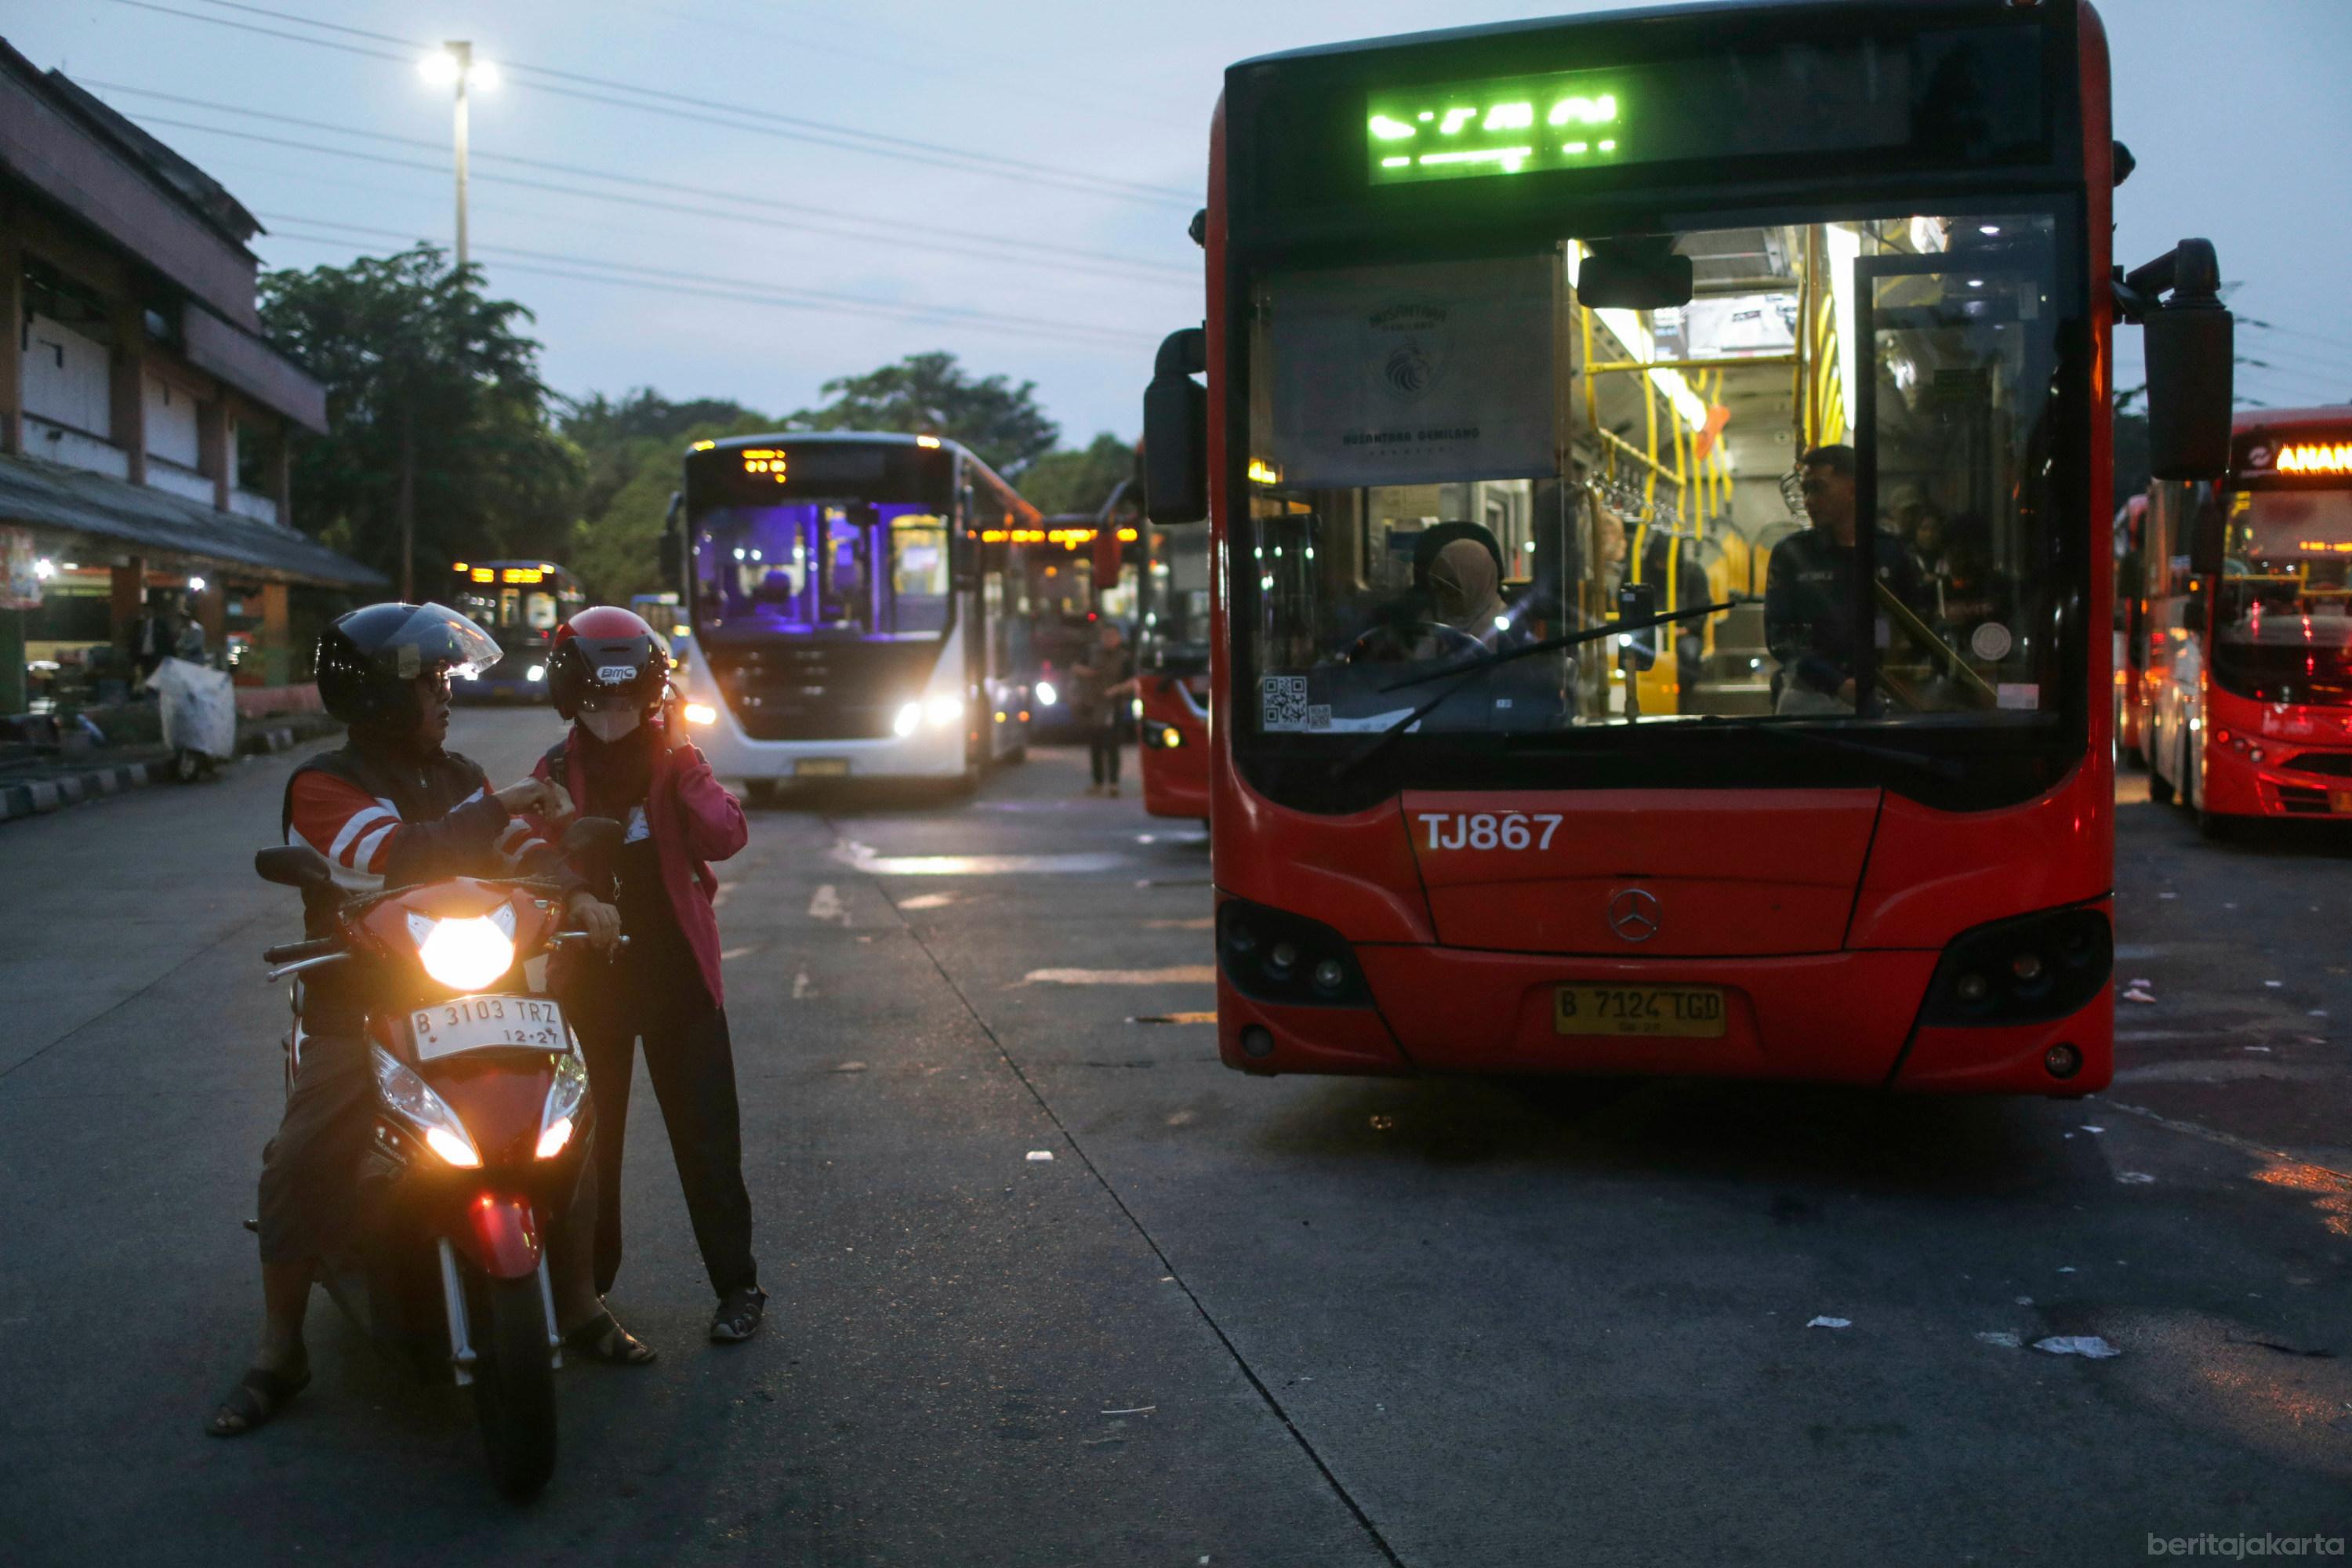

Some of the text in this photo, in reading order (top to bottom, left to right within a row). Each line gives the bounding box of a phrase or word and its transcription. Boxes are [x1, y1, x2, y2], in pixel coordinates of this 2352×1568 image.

[1417, 813, 1564, 851] TJ867
[416, 1000, 557, 1035] B 3103 TRZ
[1560, 990, 1577, 1018] B
[1661, 992, 1720, 1020] TGD
[372, 1137, 408, 1165] HONDA
